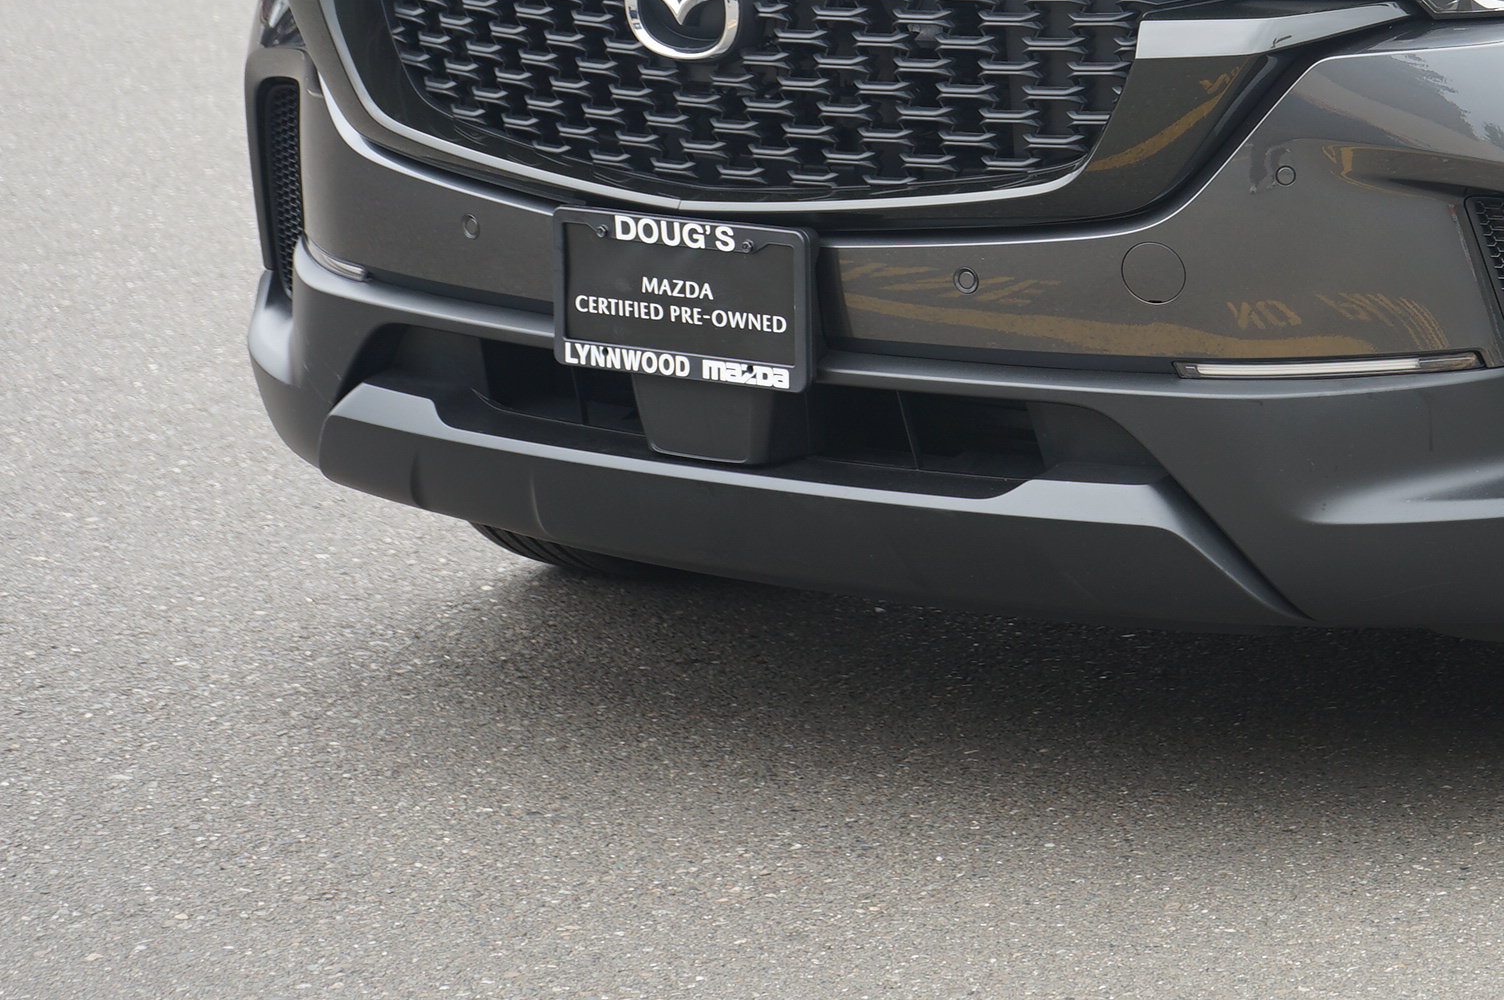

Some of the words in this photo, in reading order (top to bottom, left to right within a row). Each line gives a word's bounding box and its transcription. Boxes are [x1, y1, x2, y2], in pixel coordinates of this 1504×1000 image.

[614, 214, 736, 253] DOUG'S
[641, 276, 714, 301] MAZDA
[575, 294, 664, 321] CERTIFIED
[670, 305, 787, 334] PRE-OWNED
[564, 341, 691, 378] LYNNWOOD
